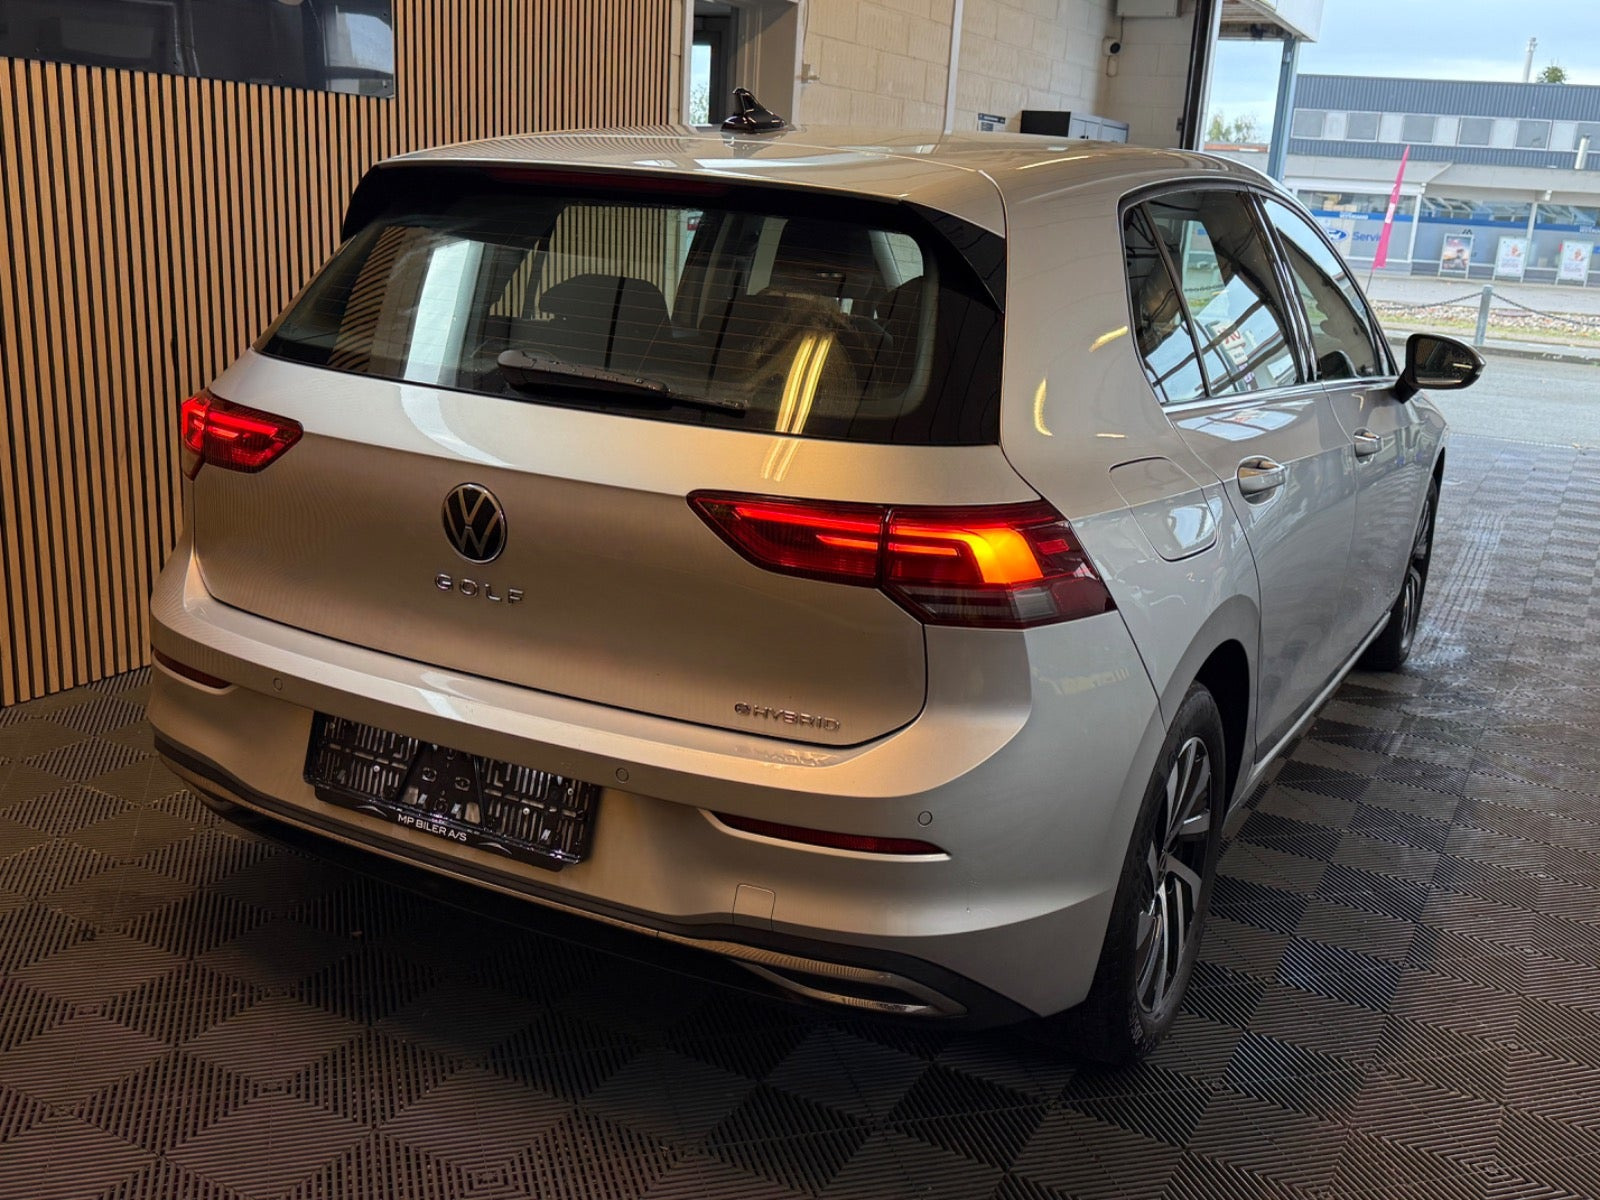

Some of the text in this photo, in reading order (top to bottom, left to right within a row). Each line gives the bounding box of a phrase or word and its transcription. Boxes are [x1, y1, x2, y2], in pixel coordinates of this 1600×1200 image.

[1353, 231, 1382, 241] Servi
[434, 573, 524, 604] GOLF
[397, 813, 467, 841] MP BILER A/S
